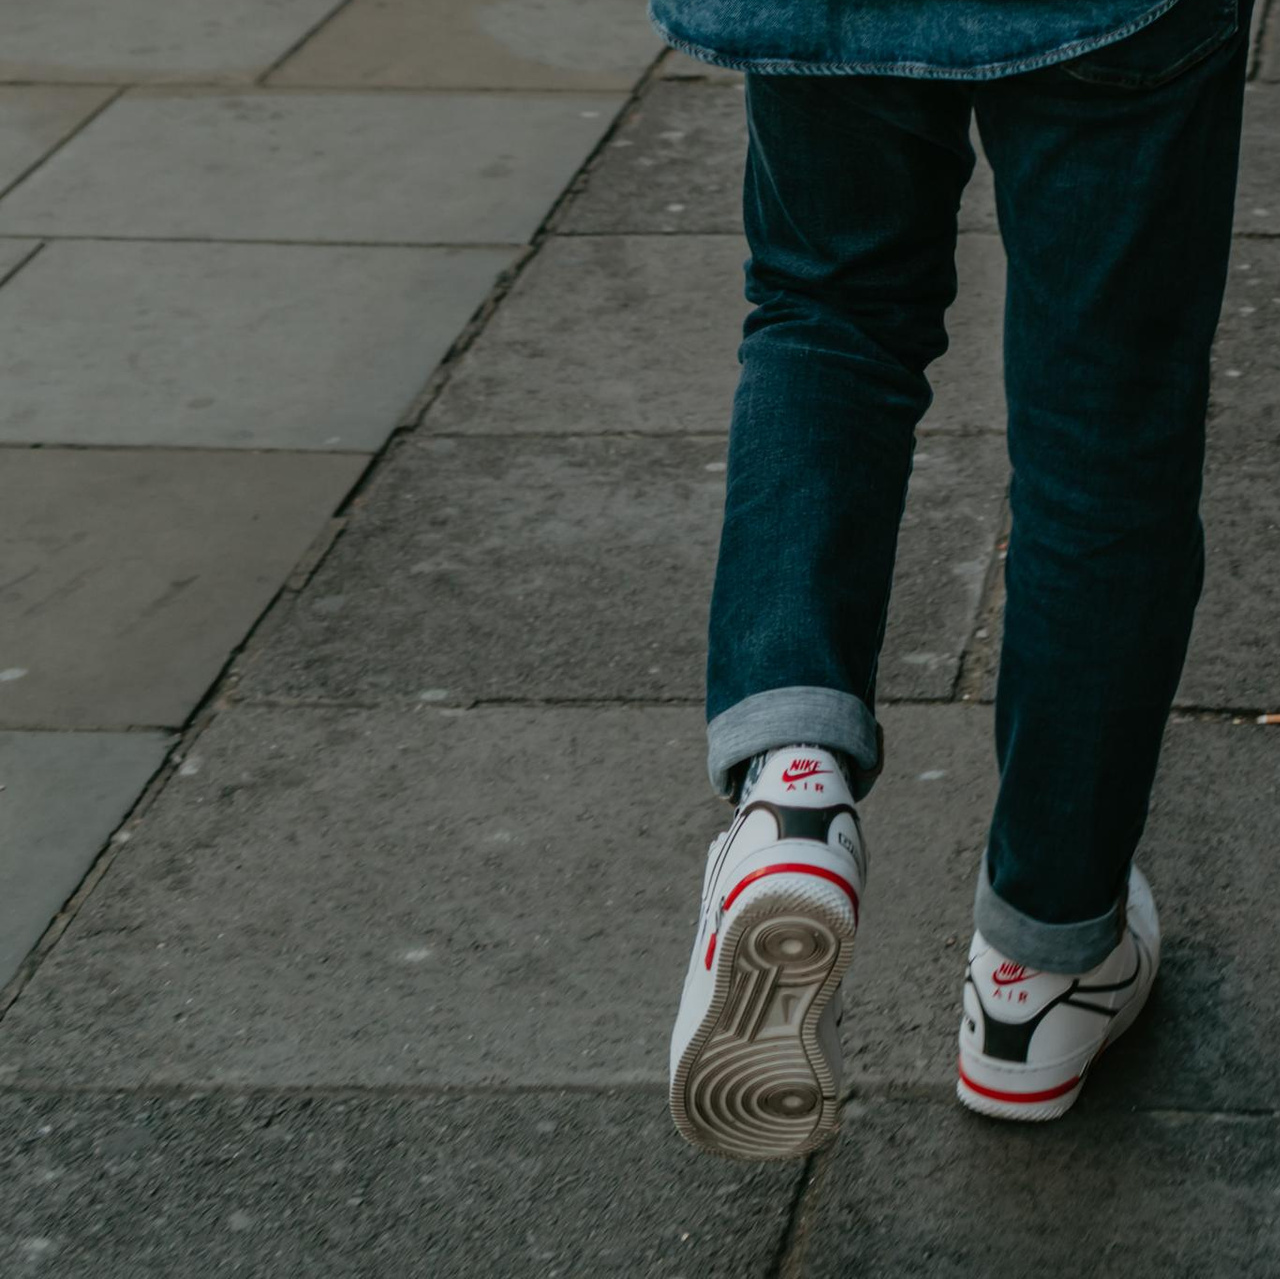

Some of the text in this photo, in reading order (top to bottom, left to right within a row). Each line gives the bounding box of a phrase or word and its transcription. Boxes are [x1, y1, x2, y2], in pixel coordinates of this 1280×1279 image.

[790, 758, 822, 772] NIKE
[786, 782, 825, 793] AIR
[992, 987, 1028, 1002] AIR
